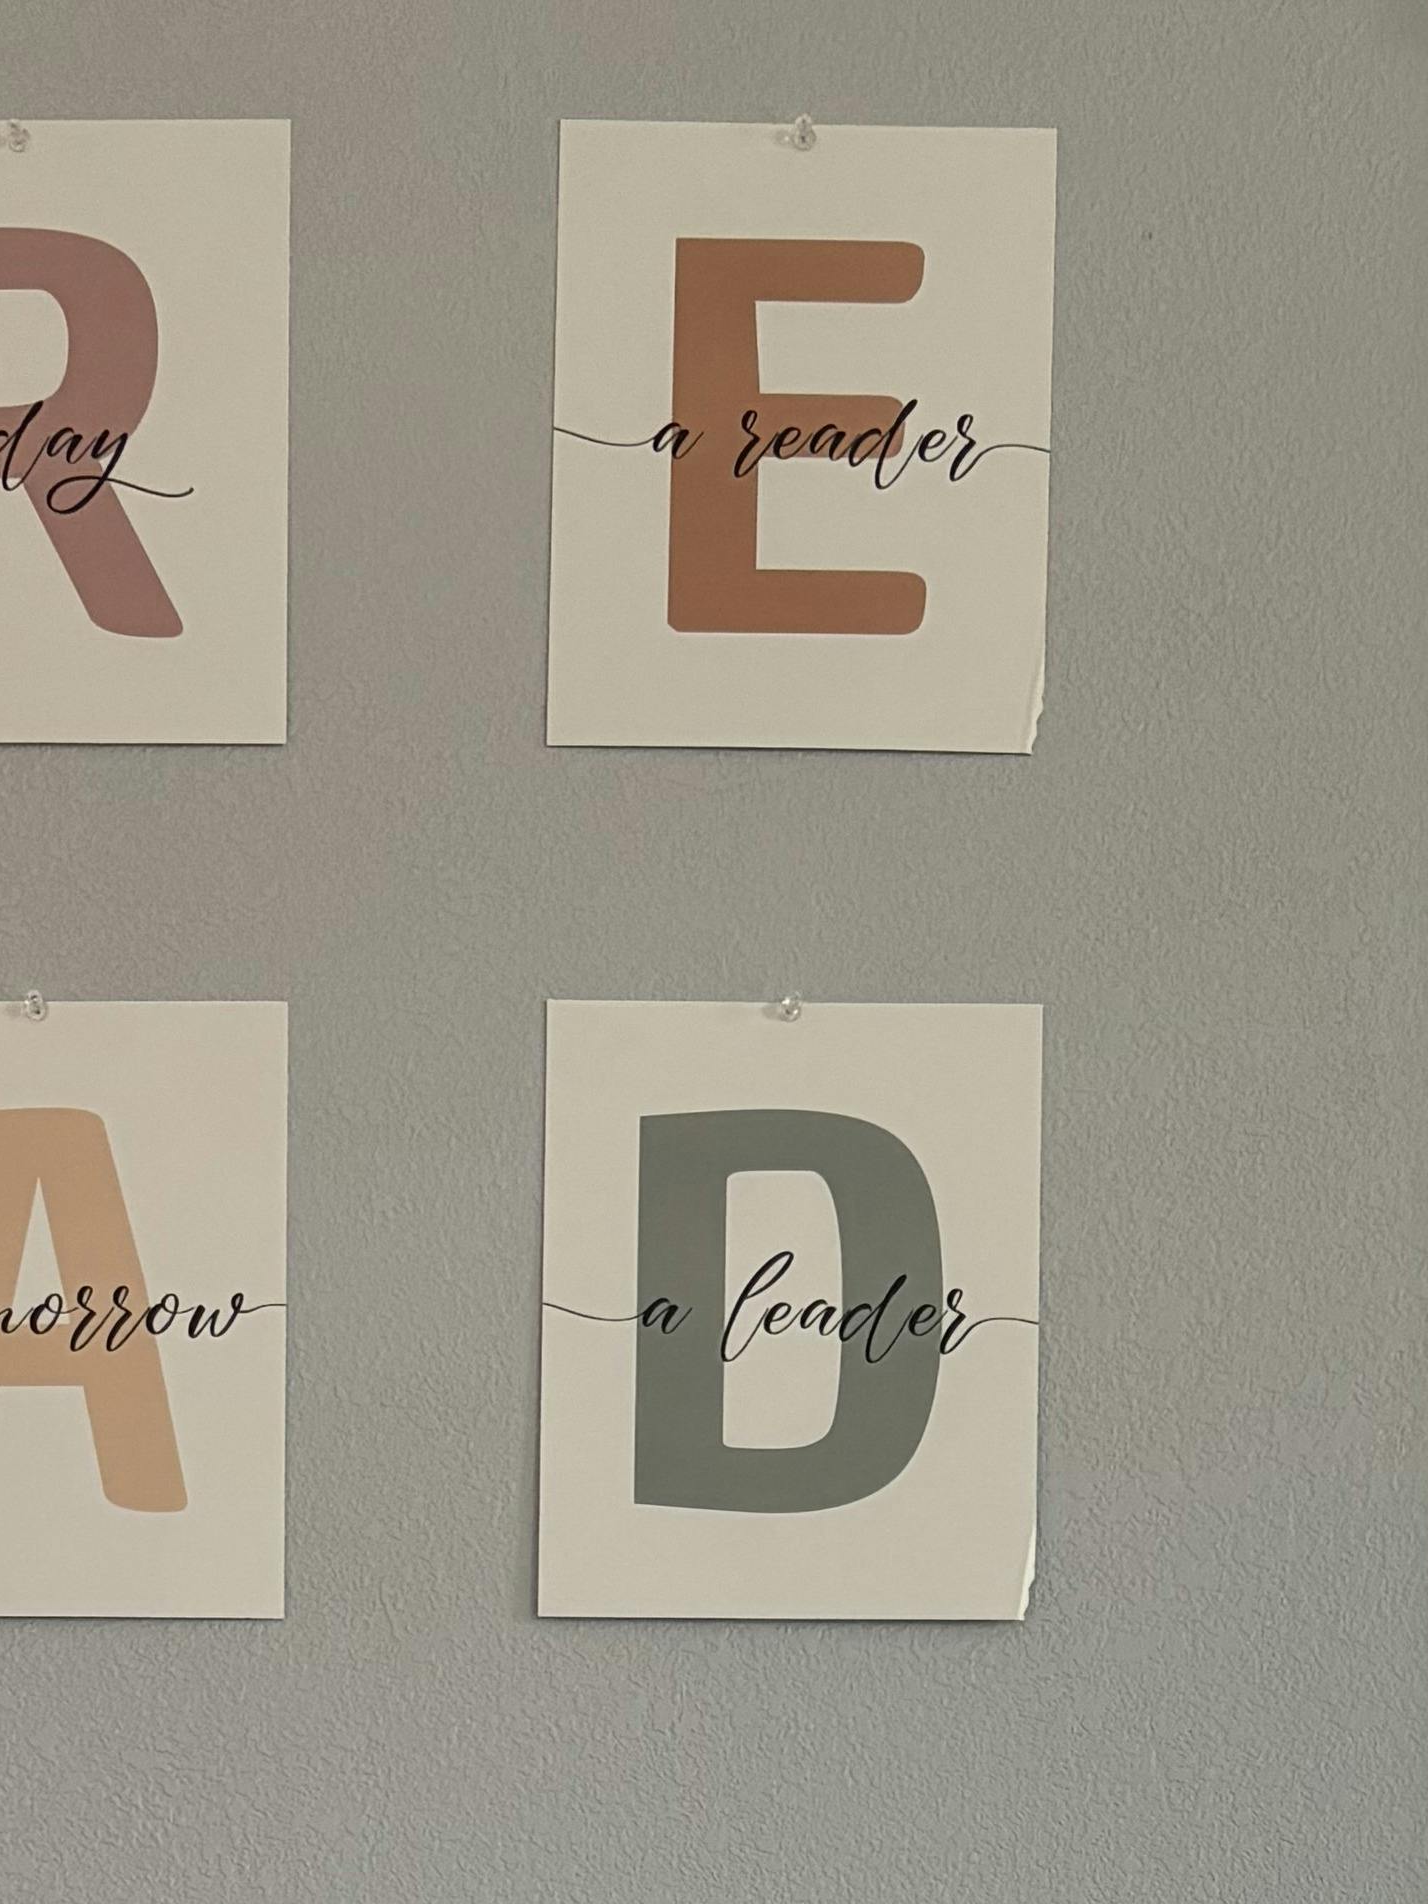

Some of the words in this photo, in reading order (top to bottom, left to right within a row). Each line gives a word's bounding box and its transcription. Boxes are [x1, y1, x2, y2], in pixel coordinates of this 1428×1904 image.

[667, 237, 928, 635] E
[736, 396, 1012, 490] reader
[633, 1108, 944, 1514] D
[721, 1250, 997, 1364] leader
